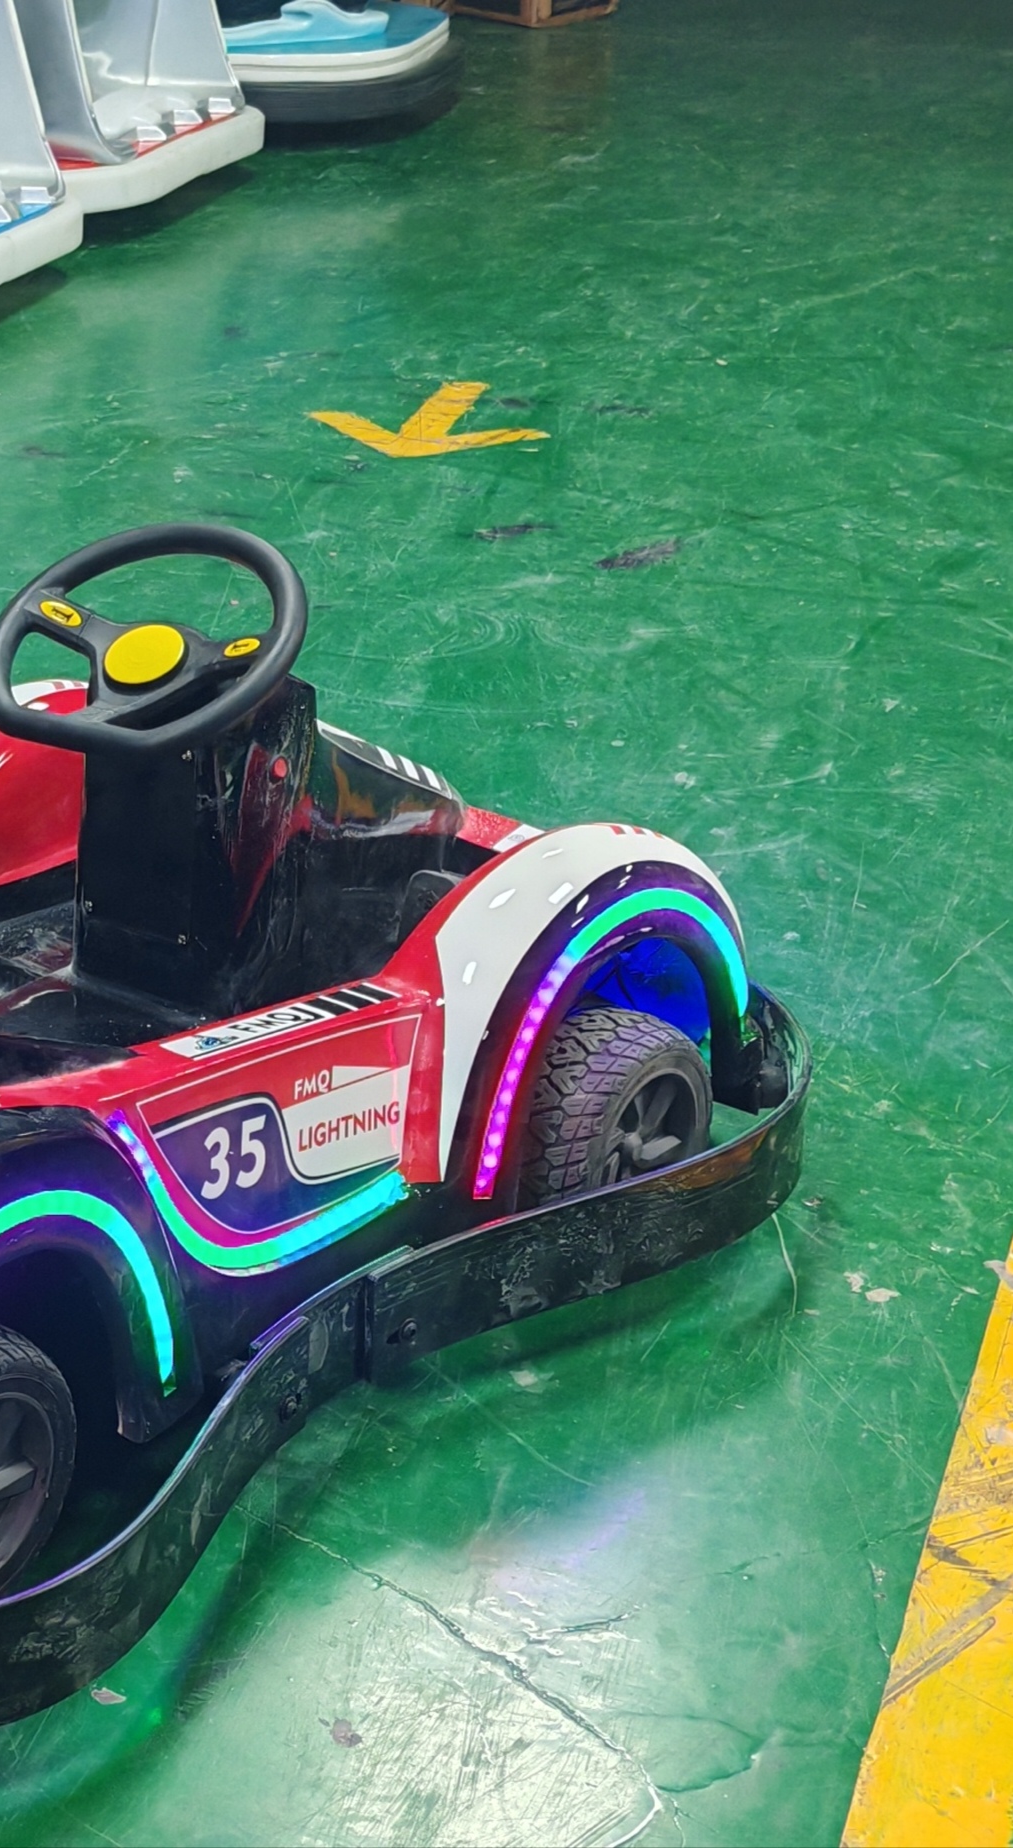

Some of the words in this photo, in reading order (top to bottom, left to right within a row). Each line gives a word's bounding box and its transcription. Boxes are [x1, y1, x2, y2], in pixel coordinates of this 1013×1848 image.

[235, 1004, 305, 1034] FMQ
[294, 1069, 329, 1100] FMQ
[298, 1101, 400, 1152] LIGHTNING
[201, 1114, 266, 1200] 35
